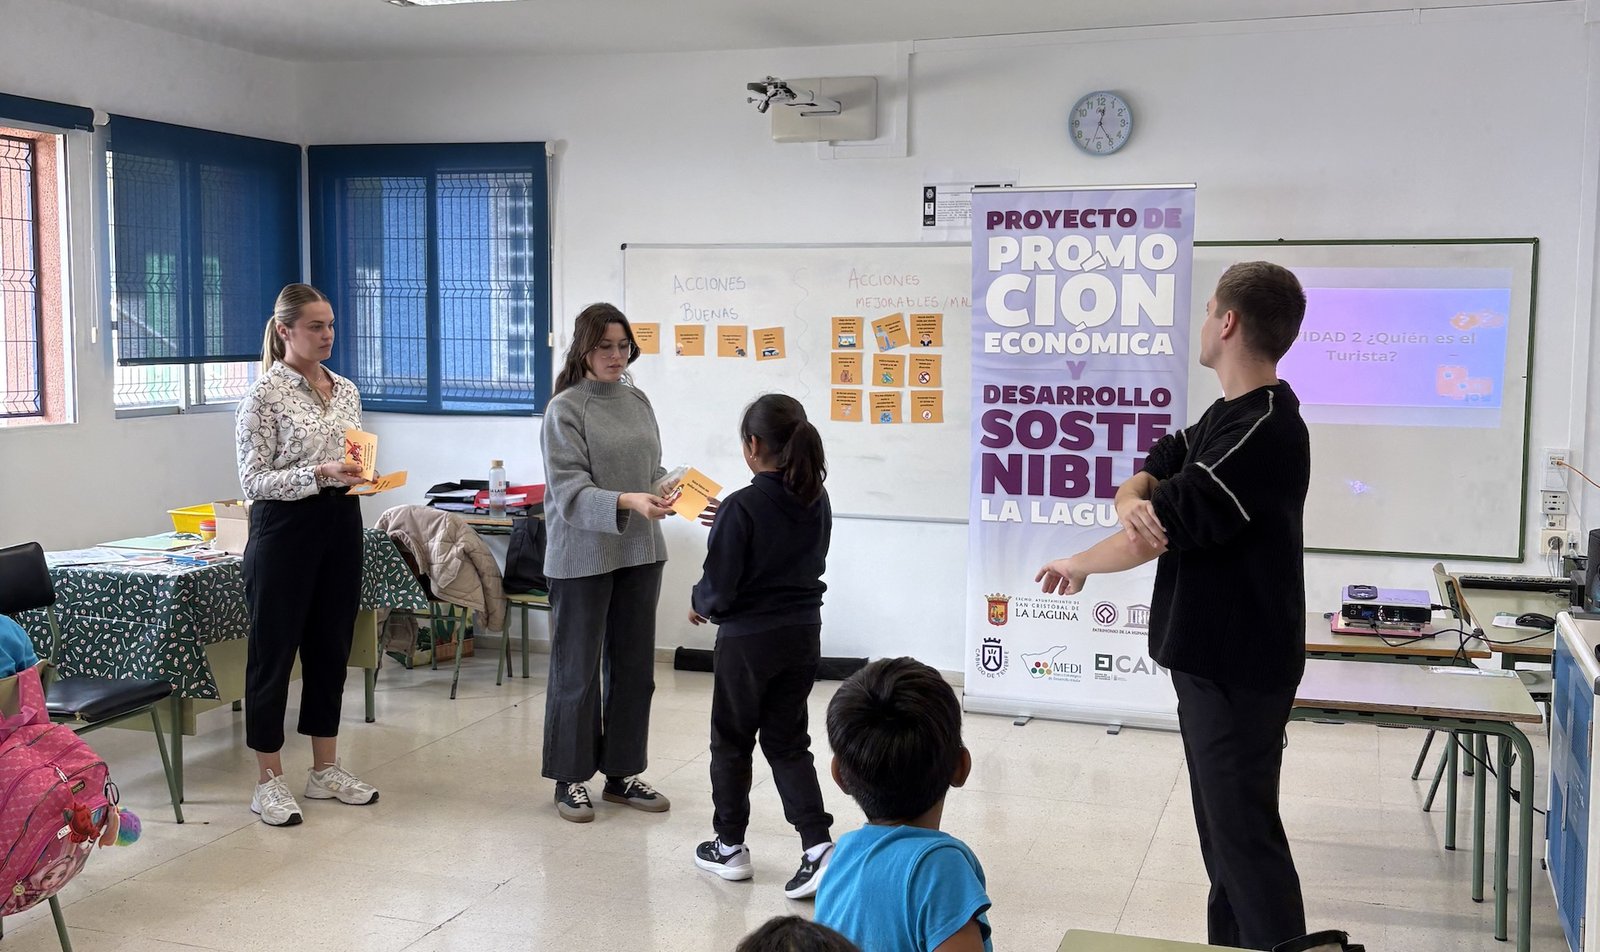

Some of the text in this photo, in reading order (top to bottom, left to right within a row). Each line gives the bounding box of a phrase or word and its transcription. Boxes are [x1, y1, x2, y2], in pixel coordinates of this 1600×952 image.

[1086, 101, 1093, 109] 11
[1097, 98, 1106, 106] 12
[1111, 101, 1115, 109] 1
[1079, 108, 1087, 117] 10
[1117, 108, 1123, 117] 2
[1074, 120, 1080, 128] 9
[1120, 119, 1126, 127] 3
[1077, 130, 1083, 139] 8
[1116, 130, 1122, 139] 4
[1085, 138, 1091, 147] 7
[1096, 141, 1102, 150] 6
[986, 208, 1182, 230] PROYECTO DE
[988, 233, 1178, 271] PROMO
[673, 274, 746, 294] ACCIONES
[848, 267, 920, 289] ACCIONES
[985, 251, 1176, 327] CIÓN
[680, 302, 739, 321] BUENAS
[984, 321, 1175, 355] ECONÓMICA
[1300, 331, 1476, 346] IDAD 2 ¿Quién es el
[1326, 350, 1398, 362] Turista?
[1066, 361, 1087, 380] Y
[983, 384, 1172, 407] DESARROLLO
[980, 408, 1172, 452] SOSTE
[980, 500, 1120, 528] LA LAGU
[1031, 602, 1068, 610] CRISTÓBAL
[1015, 608, 1079, 621] LA LAGUNA
[1053, 662, 1082, 674] MEDI
